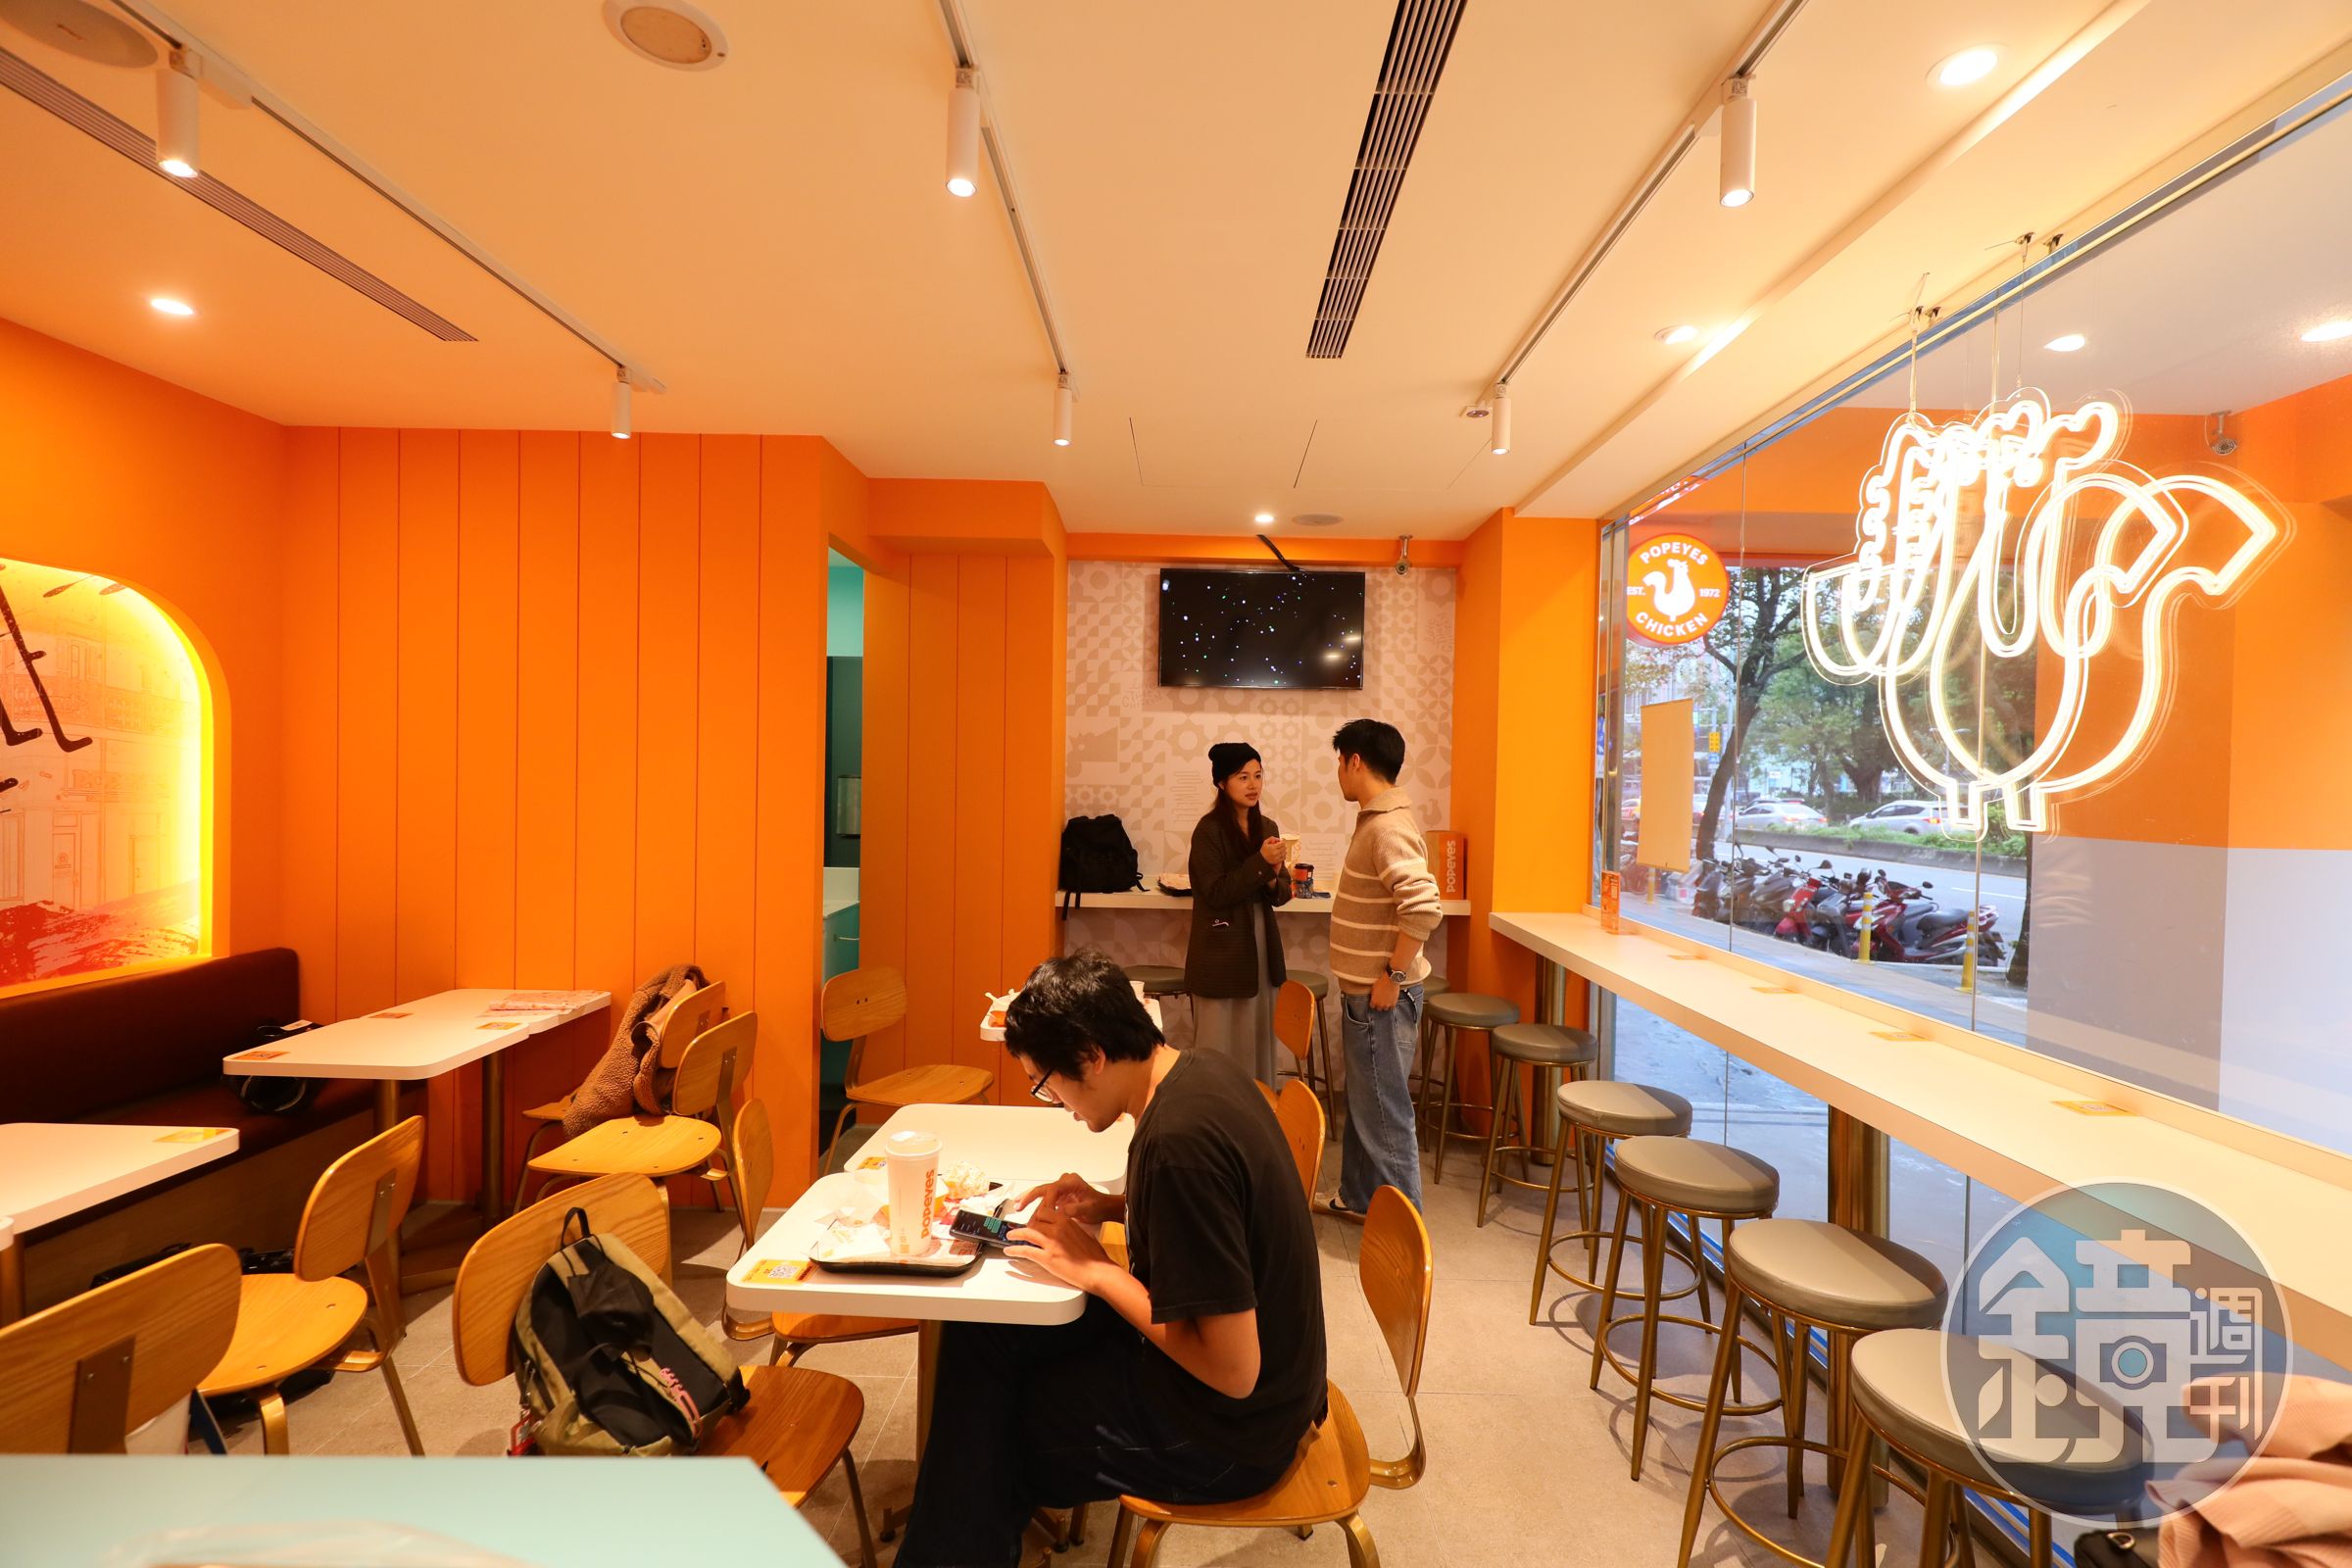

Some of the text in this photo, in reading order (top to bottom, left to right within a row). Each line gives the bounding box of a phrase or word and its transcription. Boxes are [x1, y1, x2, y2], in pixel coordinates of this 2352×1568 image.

[1640, 541, 1708, 565] POPEYES
[1698, 588, 1721, 598] 1972
[1636, 612, 1708, 637] CHICKEN
